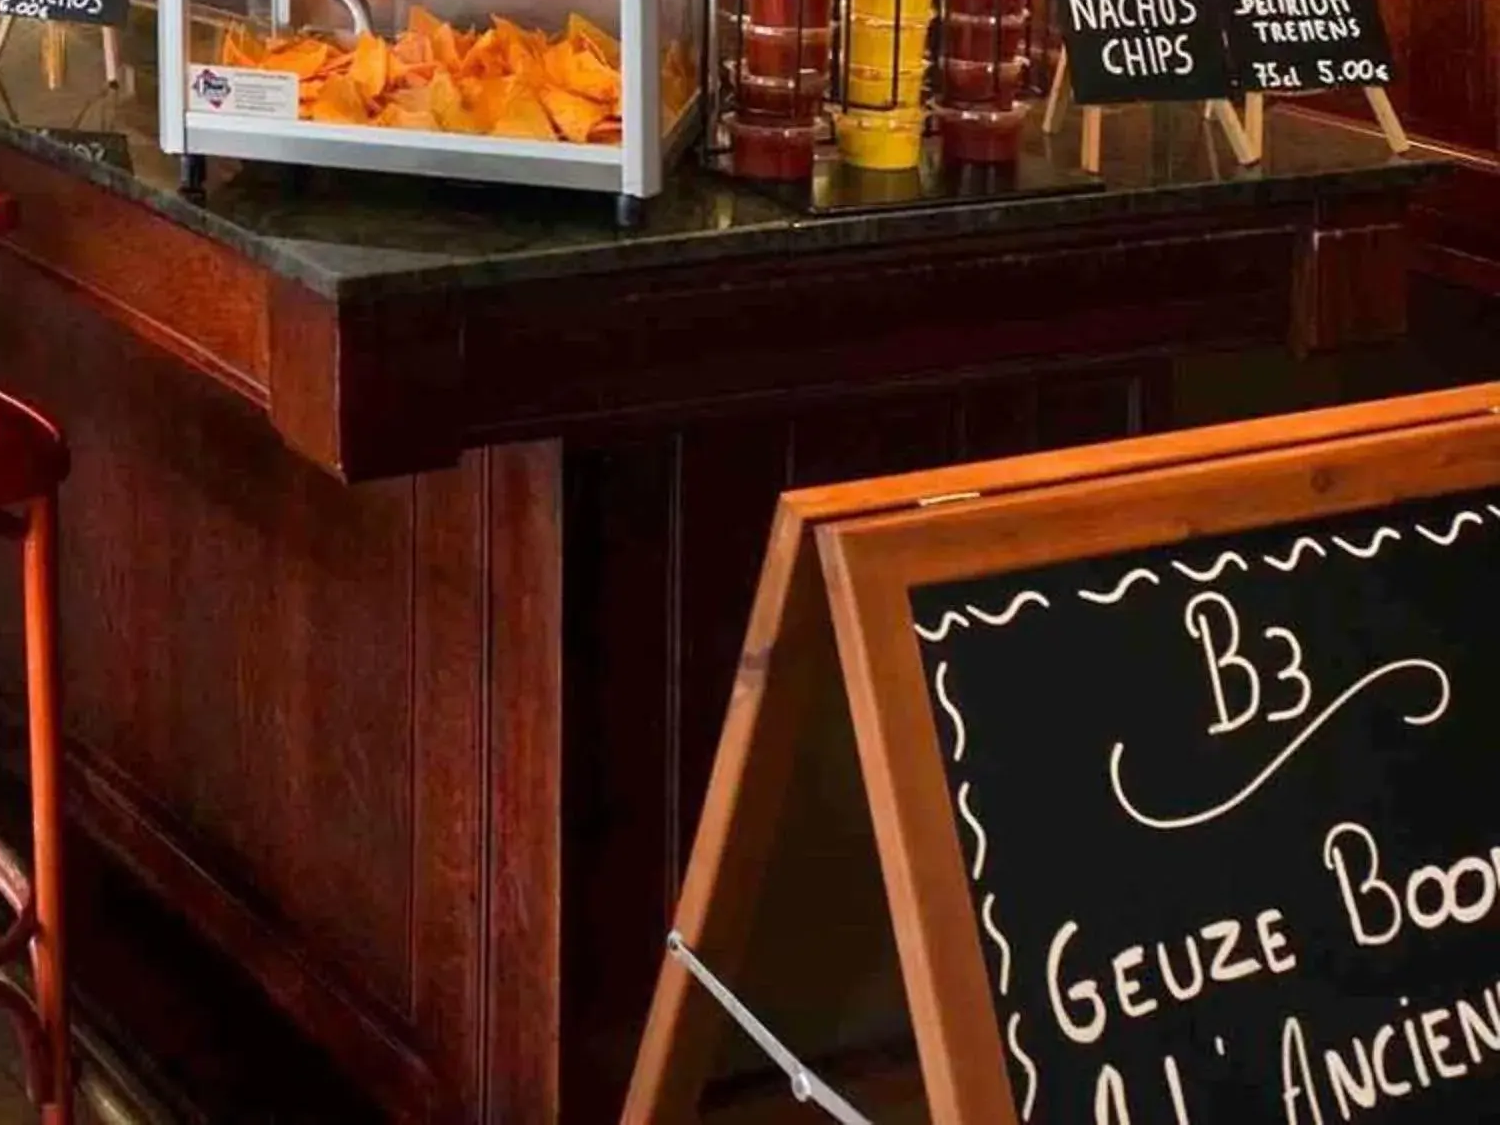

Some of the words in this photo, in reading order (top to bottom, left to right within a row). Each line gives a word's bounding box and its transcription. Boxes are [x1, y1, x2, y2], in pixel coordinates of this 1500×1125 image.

[1252, 17, 1361, 43] TREMENS
[1317, 59, 1390, 84] 5.00€
[1185, 591, 1312, 735] B3
[1047, 908, 1297, 1044] GEUZE
[1324, 822, 1500, 946] BOO
